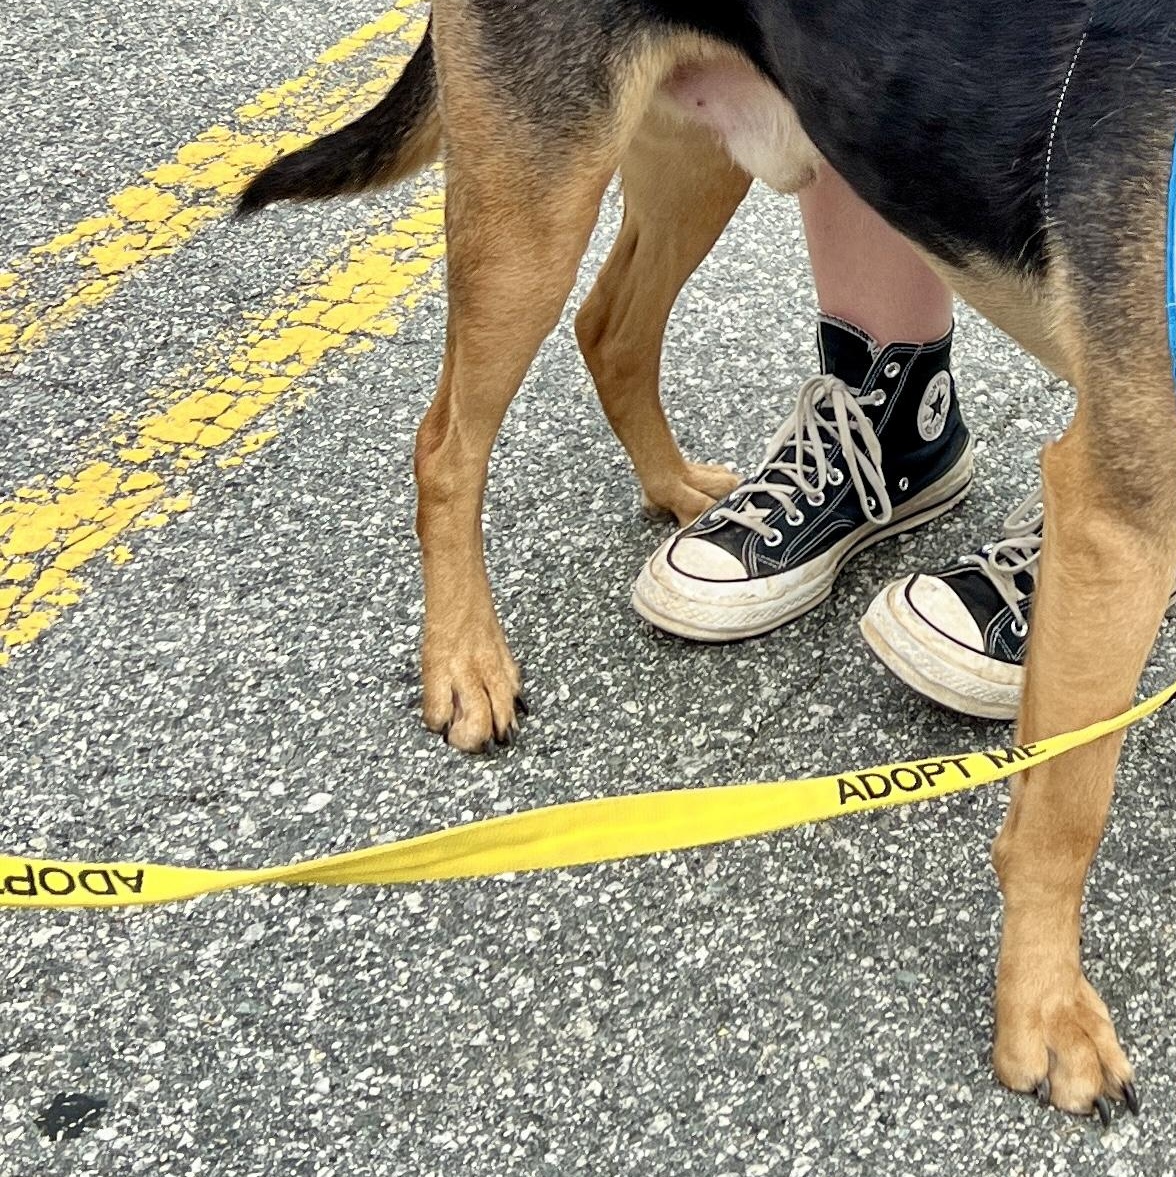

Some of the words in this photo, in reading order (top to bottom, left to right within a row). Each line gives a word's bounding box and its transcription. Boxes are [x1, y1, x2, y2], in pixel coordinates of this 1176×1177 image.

[837, 757, 971, 805] ADOPT
[983, 744, 1047, 769] ME
[0, 864, 144, 896] ADOP
